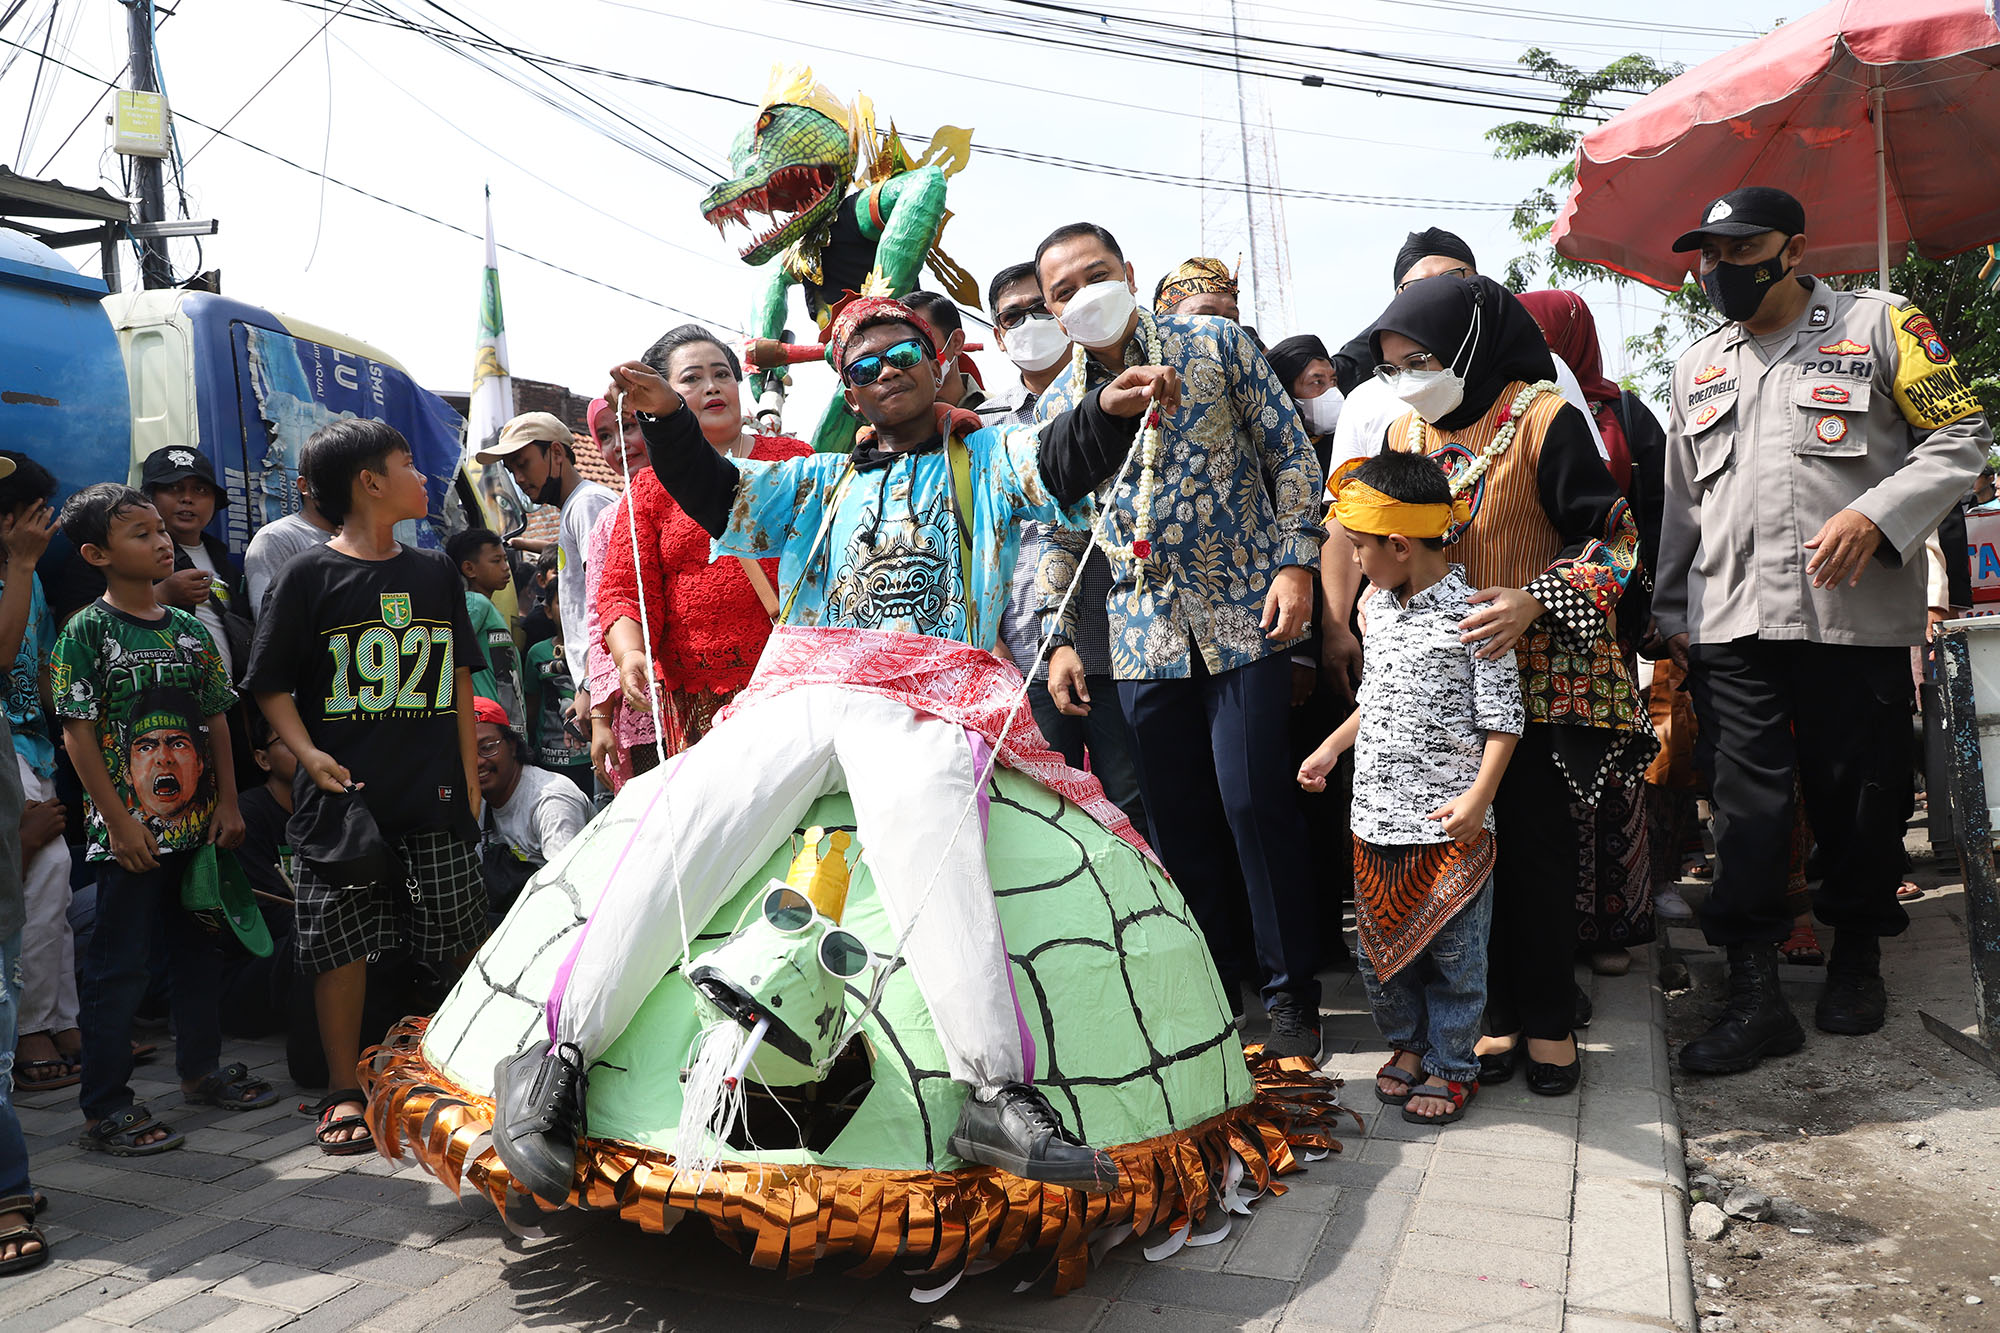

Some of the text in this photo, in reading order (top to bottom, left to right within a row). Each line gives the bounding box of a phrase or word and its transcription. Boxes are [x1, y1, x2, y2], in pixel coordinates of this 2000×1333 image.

[1802, 360, 1872, 377] POLRI
[1689, 377, 1738, 406] ROEZZOELLY
[1921, 405, 1948, 420] KEL.
[1931, 405, 1966, 425] KEC.
[325, 626, 455, 714] 1927
[351, 712, 387, 720] NEVE
